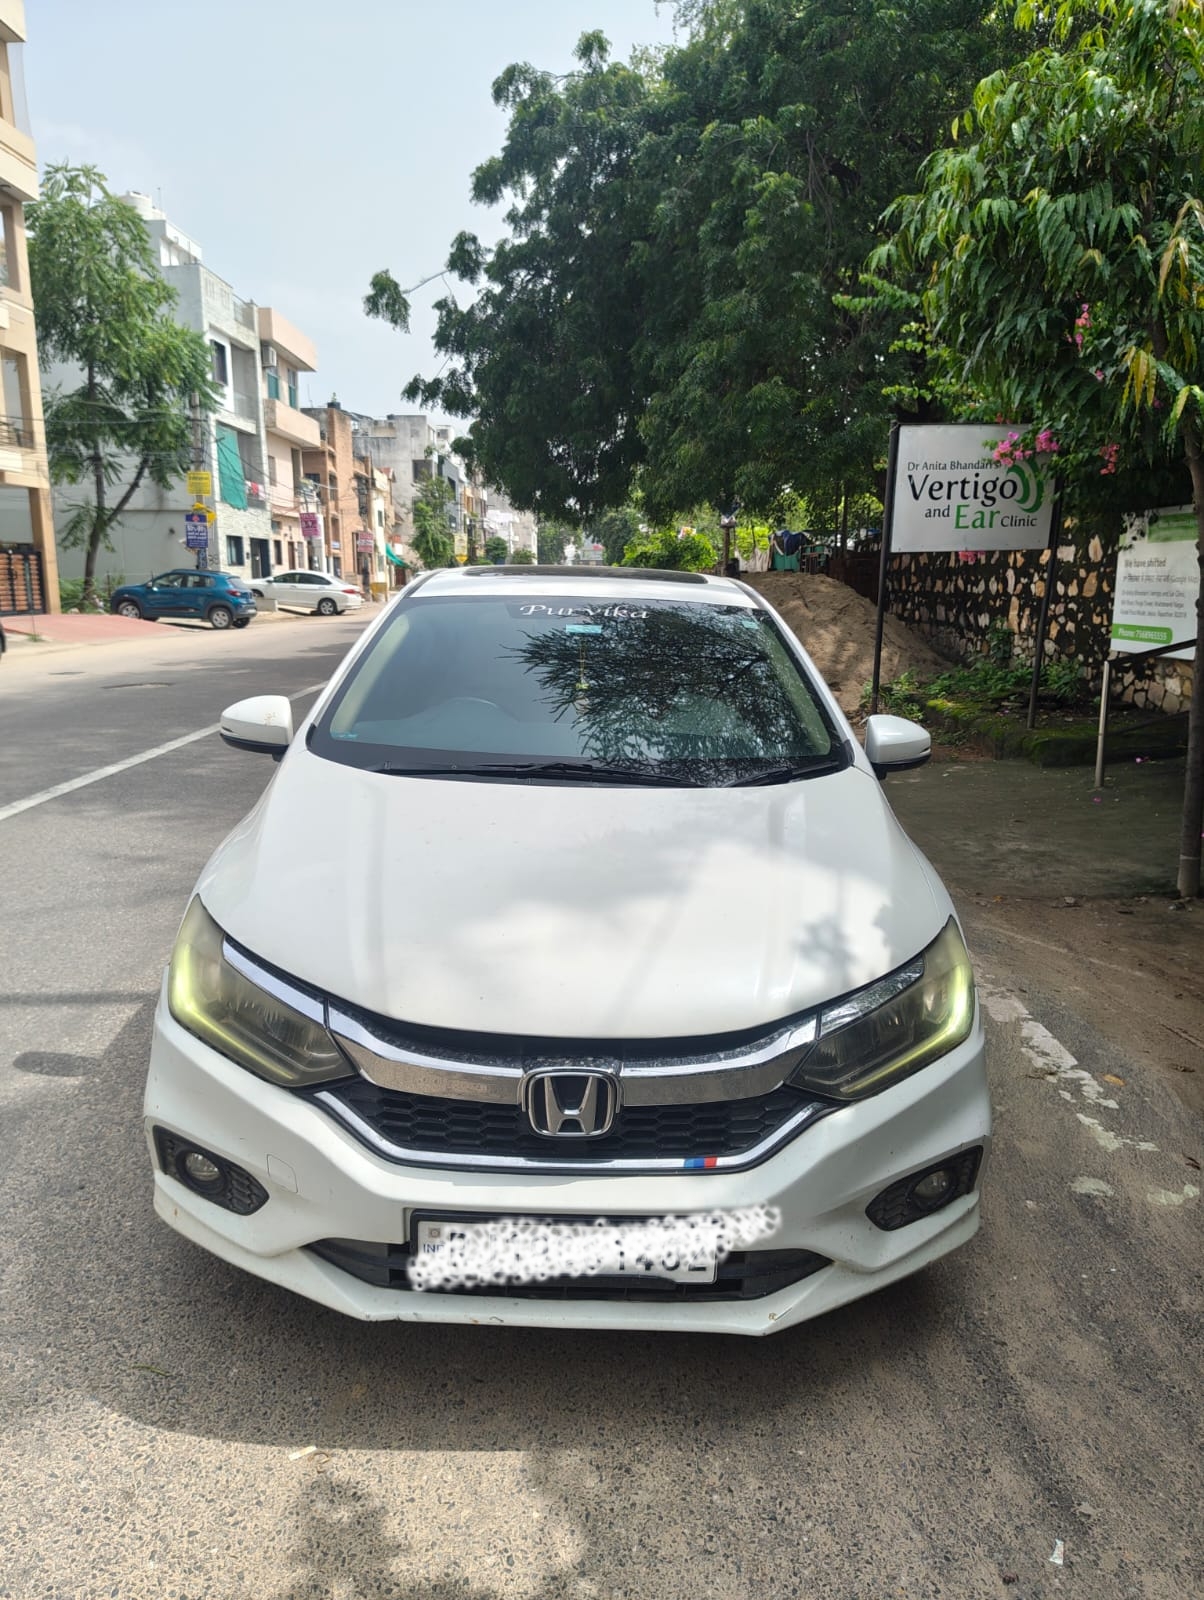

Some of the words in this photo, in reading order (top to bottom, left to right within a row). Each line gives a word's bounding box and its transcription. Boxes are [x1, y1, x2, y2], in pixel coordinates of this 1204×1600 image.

[907, 462, 920, 471] Dr
[922, 461, 947, 471] Anita
[907, 472, 1018, 507] Vertigo
[925, 504, 950, 518] and
[954, 504, 1001, 529] Ear
[1001, 516, 1037, 528] Clinic
[519, 604, 651, 619] Purvika
